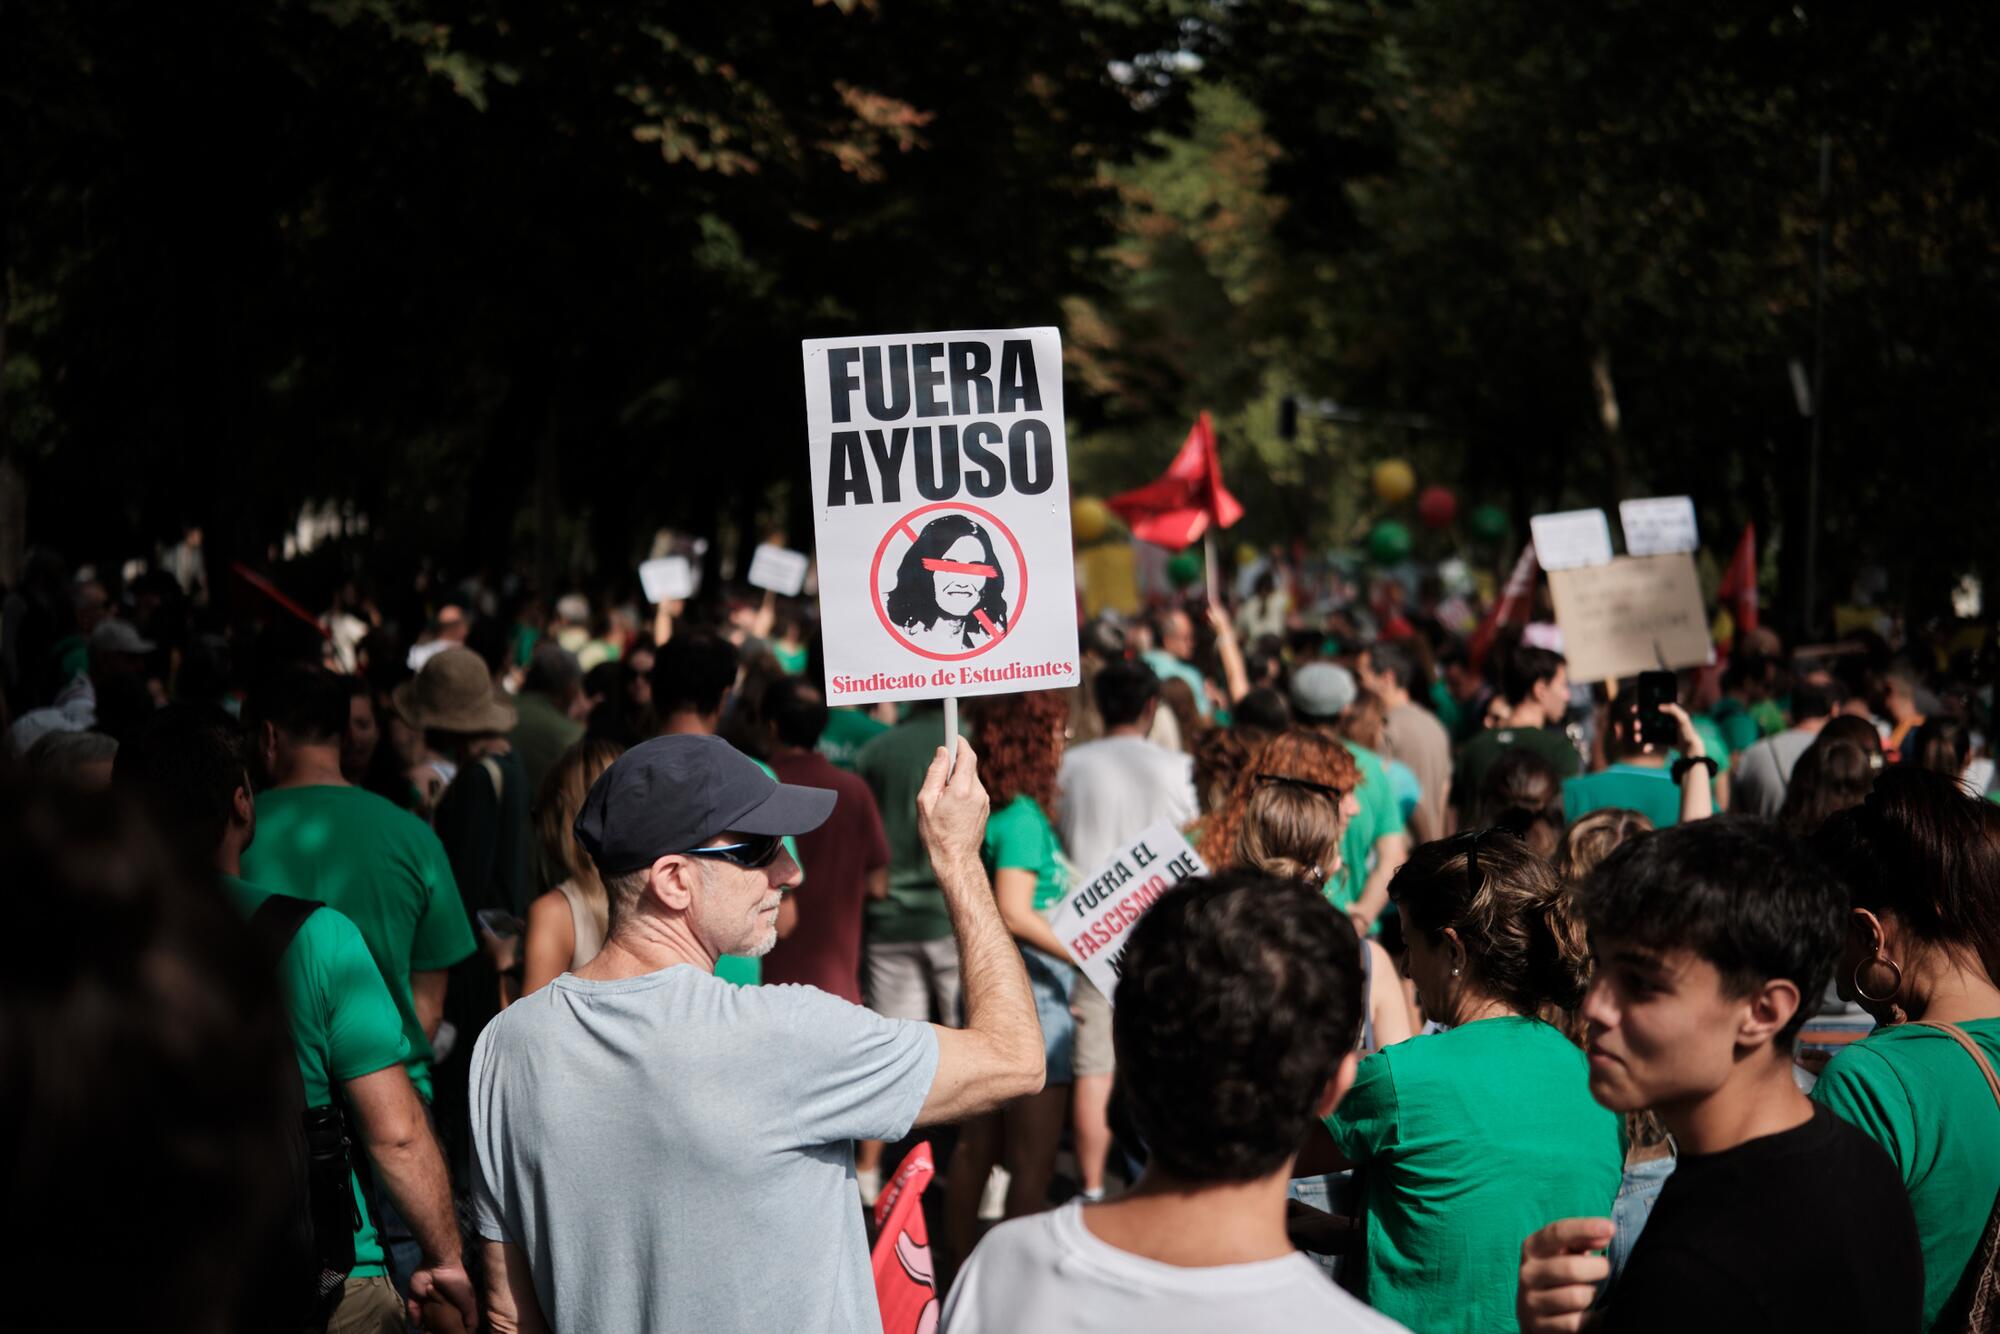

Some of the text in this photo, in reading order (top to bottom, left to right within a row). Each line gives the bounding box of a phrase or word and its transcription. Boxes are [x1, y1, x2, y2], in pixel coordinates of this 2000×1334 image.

[827, 339, 1043, 424] FUERA
[826, 418, 1055, 507] AYUSO
[832, 660, 1073, 695] Sindicato de Estudiantes
[1070, 874, 1169, 962] FASCISMO
[1164, 851, 1200, 884] DE
[1071, 842, 1158, 919] FUERA EL
